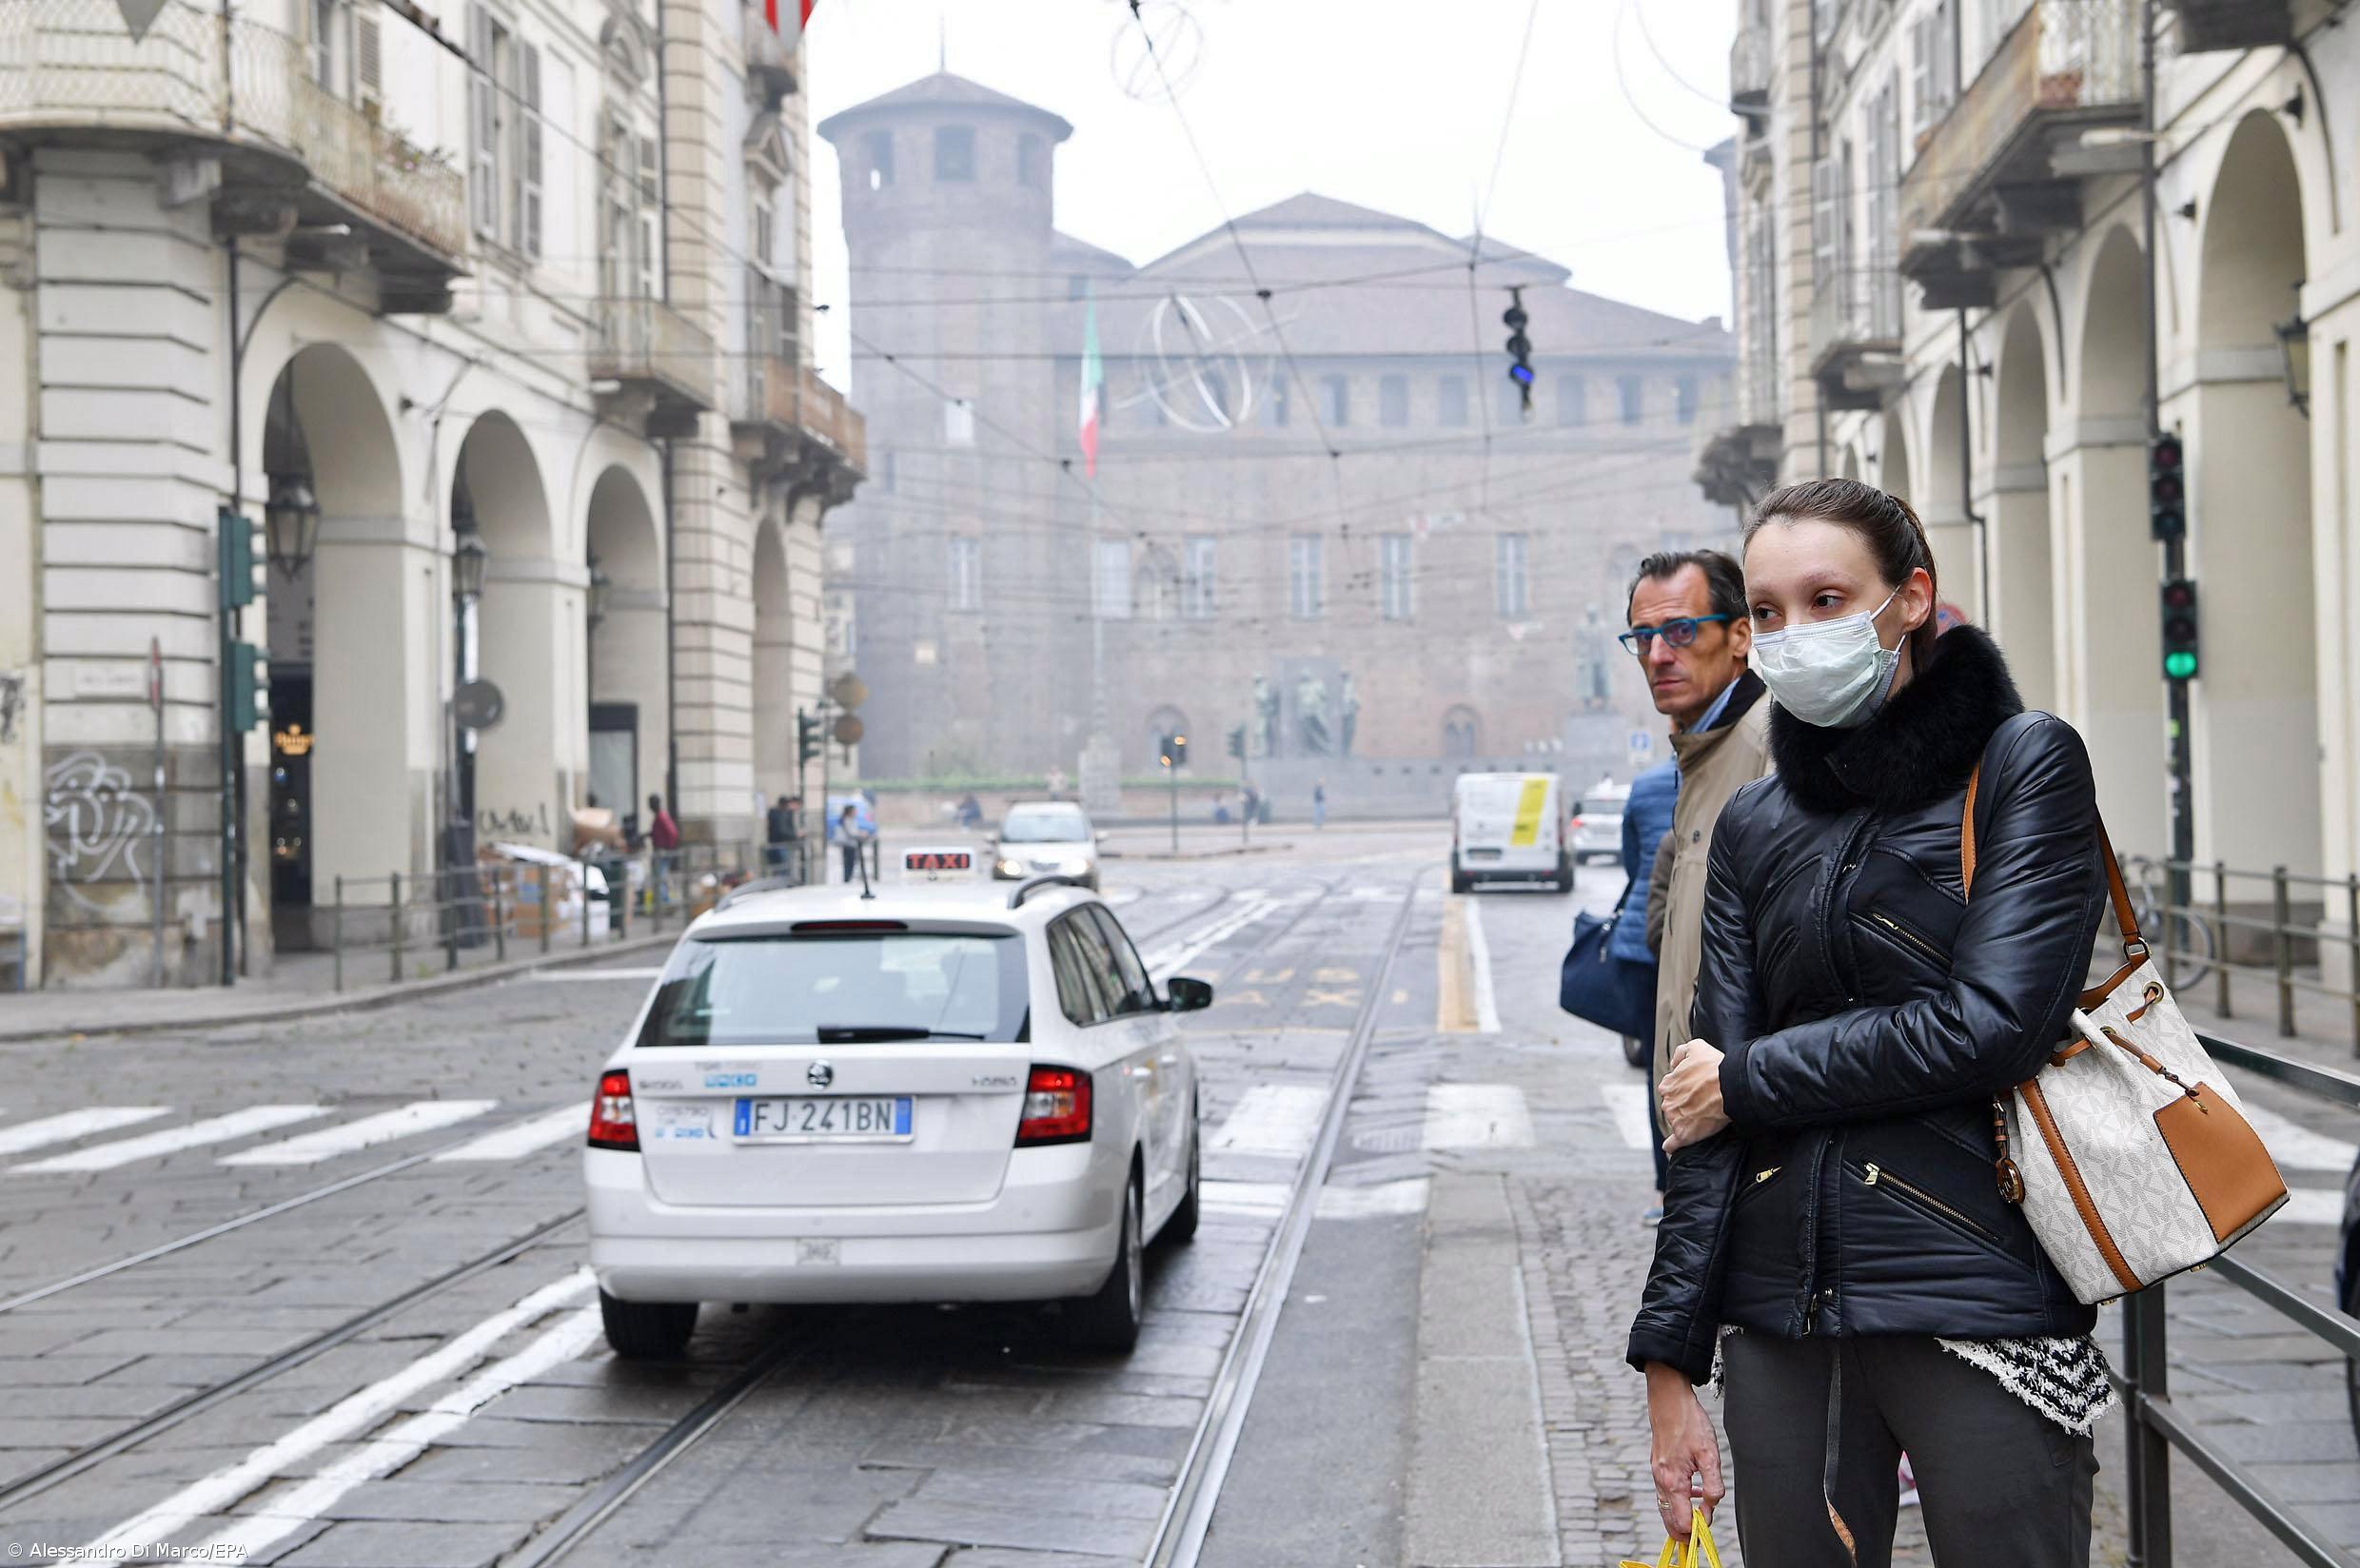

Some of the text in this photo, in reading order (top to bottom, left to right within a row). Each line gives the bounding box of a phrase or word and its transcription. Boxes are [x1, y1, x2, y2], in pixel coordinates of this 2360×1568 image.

[909, 853, 968, 869] TAXI
[754, 1102, 891, 1132] FJ 241BN
